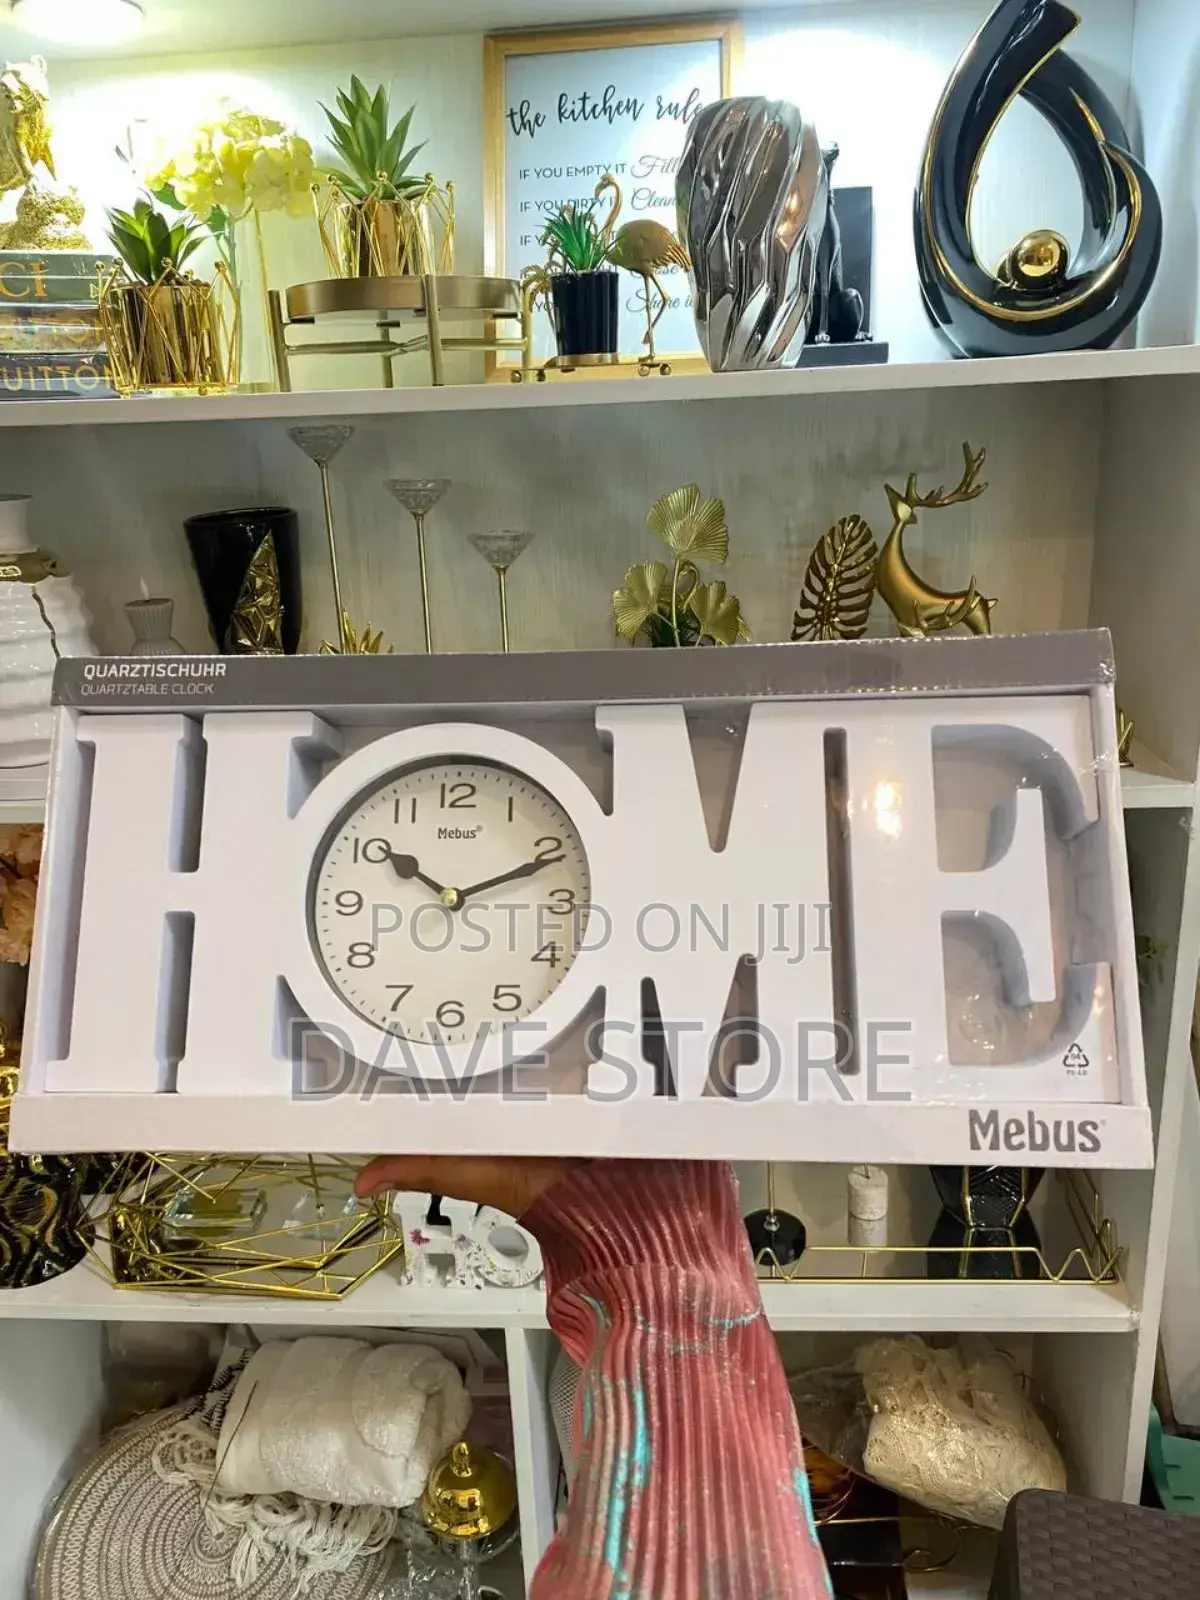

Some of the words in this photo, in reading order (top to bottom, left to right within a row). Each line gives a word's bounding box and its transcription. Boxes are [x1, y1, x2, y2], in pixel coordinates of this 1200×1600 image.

[505, 99, 546, 138] the
[558, 84, 645, 125] kitchen
[519, 169, 530, 180] IF
[534, 167, 562, 179] YOU
[566, 164, 612, 177] EMPTY
[615, 163, 627, 174] IT
[519, 201, 531, 212] IF
[534, 199, 563, 211] YOU
[519, 234, 531, 246] IF
[83, 663, 227, 680] QUARZTISCHUHR
[80, 683, 169, 696] QUARTZTABLE
[172, 683, 215, 695] CLOCK
[440, 782, 477, 809] 12
[393, 798, 417, 824] 11
[507, 796, 514, 823] 1
[353, 837, 392, 864] 10
[533, 836, 564, 863] 2
[335, 890, 364, 916] 9
[547, 889, 576, 915] 3
[347, 942, 375, 969] 8
[531, 941, 561, 968] 4
[385, 984, 414, 1012] 7
[492, 984, 522, 1012] 5
[435, 1000, 466, 1028] 6
